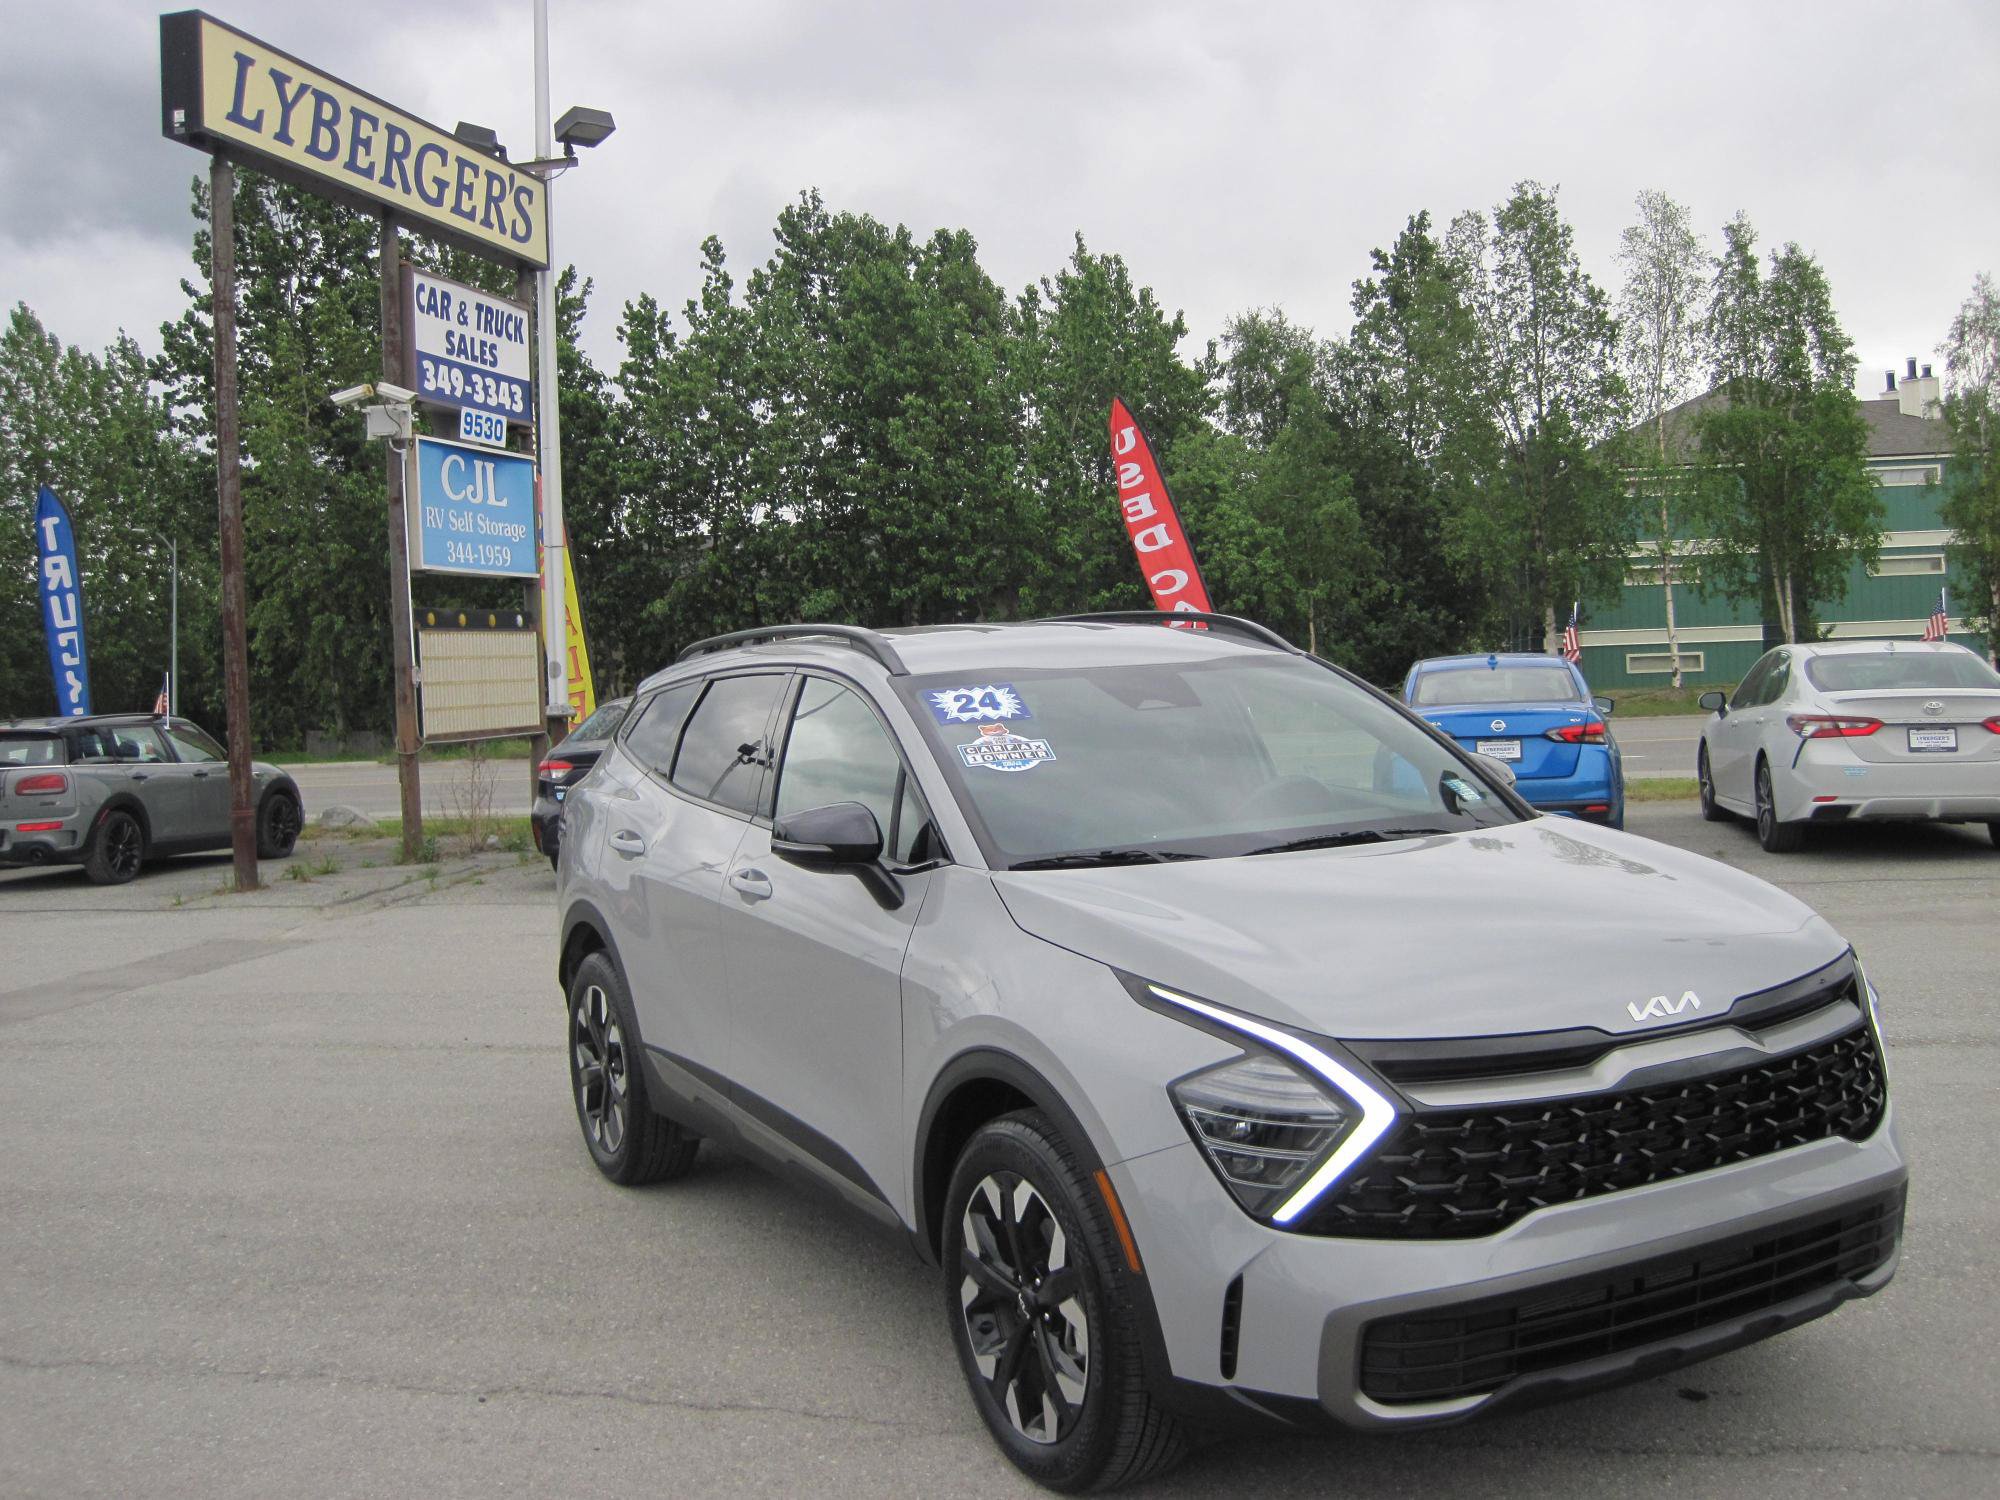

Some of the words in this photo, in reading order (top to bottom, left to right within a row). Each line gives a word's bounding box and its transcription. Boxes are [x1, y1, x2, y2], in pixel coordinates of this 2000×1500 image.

[226, 51, 534, 243] LYBERGER'S
[416, 283, 451, 321] CAR
[457, 301, 469, 327] &
[475, 302, 524, 344] TRUCK
[445, 329, 498, 368] SALES
[422, 360, 524, 413] 349-3343
[464, 412, 503, 441] 9530
[441, 454, 508, 507] CJL
[426, 506, 444, 529] RV
[448, 510, 474, 533] Self
[477, 513, 526, 542] Storage
[447, 541, 511, 567] 344-1959
[954, 691, 1002, 713] 24
[966, 743, 1044, 755] CARFAX
[984, 751, 1047, 761] OWNER
[1626, 990, 1700, 1021] KIA
